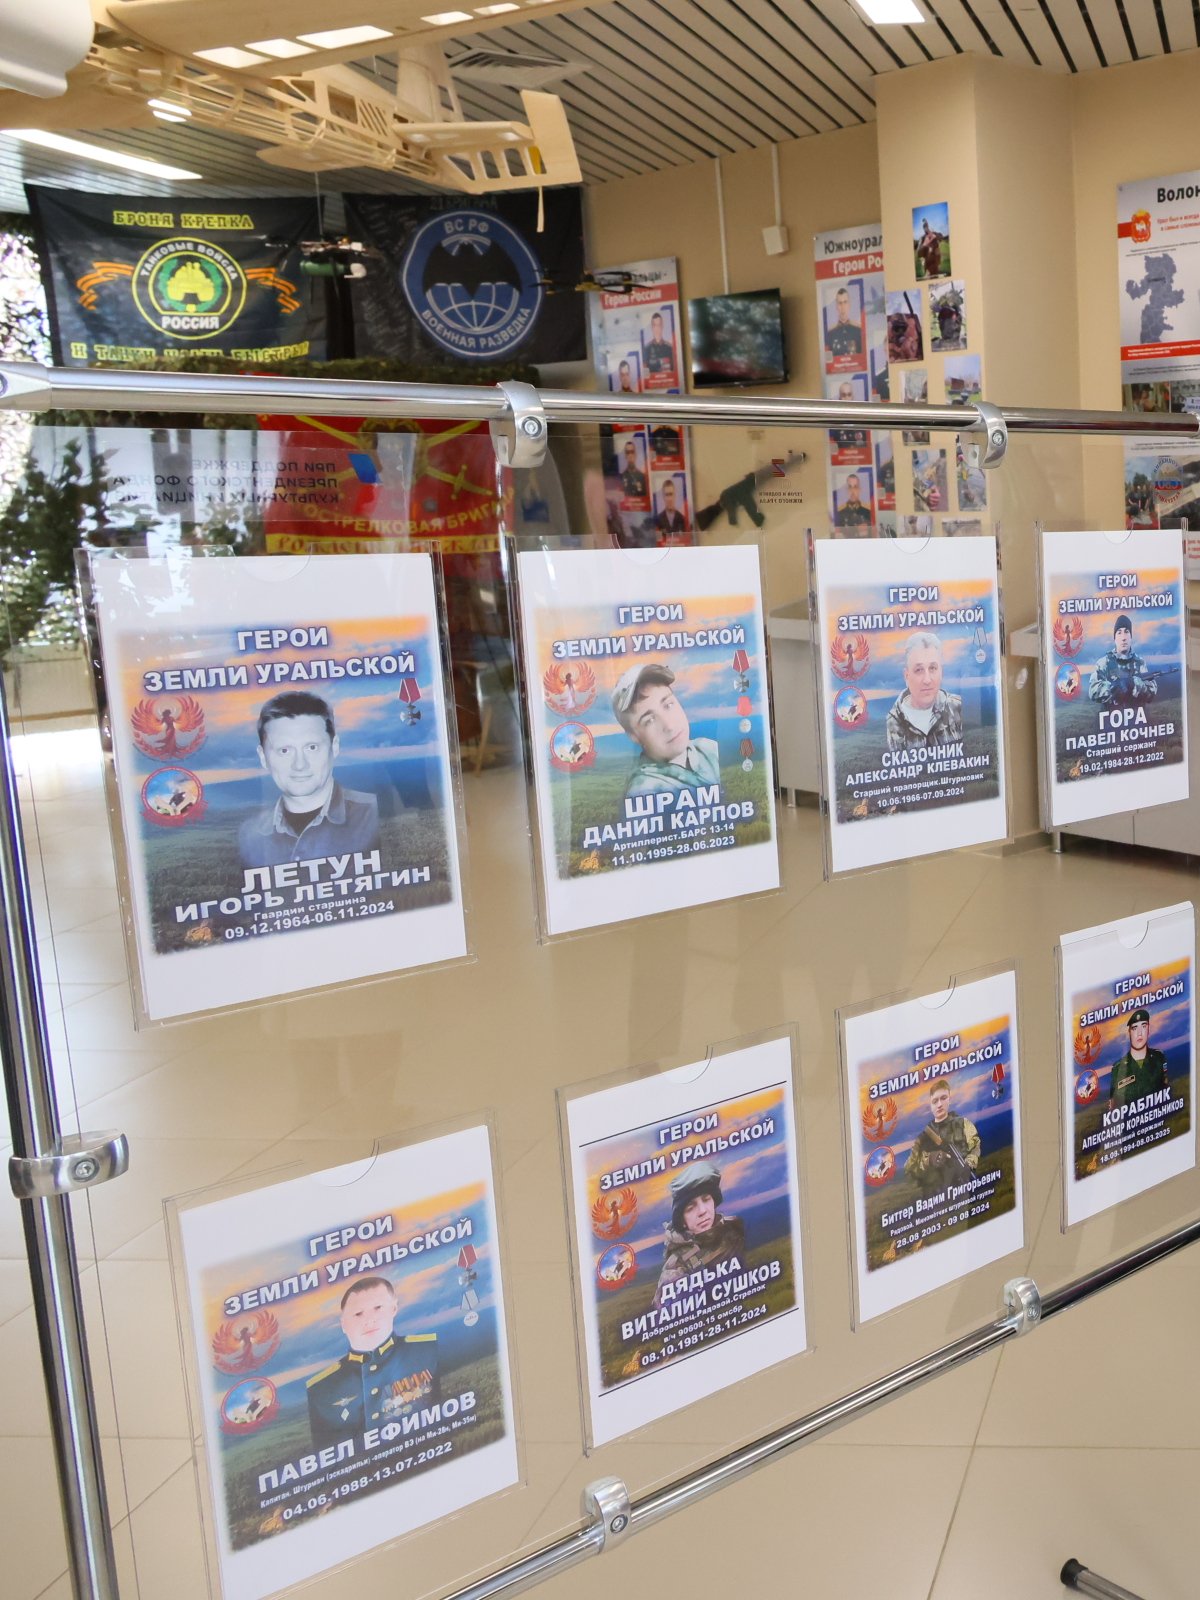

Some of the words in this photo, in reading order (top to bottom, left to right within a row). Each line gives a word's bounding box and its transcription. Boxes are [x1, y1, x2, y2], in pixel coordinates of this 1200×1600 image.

[113, 211, 174, 228] БРОНЯ
[181, 213, 255, 229] КРЕПКА
[443, 219, 465, 234] ВС
[468, 219, 490, 233] РФ
[140, 242, 194, 277] ТАНКОВЫЕ
[197, 245, 239, 281] ВОЙСКА
[833, 259, 865, 276] Герои
[161, 316, 220, 330] РОССИЯ
[421, 309, 476, 349] ВОЕННАЯ
[480, 307, 532, 349] РАЗВЕДКА
[889, 586, 939, 603] ГЕРОИ
[1099, 574, 1137, 588] ГЕРОИ
[619, 604, 683, 624] ГЕРОИ
[838, 613, 894, 631] ЗЕМЛИ
[898, 606, 984, 628] УРАЛЬСКОЙ
[1059, 599, 1102, 614] ЗЕМЛИ
[1106, 591, 1173, 611] УРАЛЬСКОЙ
[237, 626, 328, 651] ГЕРОИ
[553, 637, 626, 659] ЗЕМЛИ
[632, 624, 745, 652] УРАЛЬСКОЙ
[144, 666, 248, 692] ЗЕМЛИ
[256, 651, 416, 684] УРАЛЬСКОЙ
[1099, 706, 1147, 730] ГОРА
[1066, 732, 1116, 751] ПАВЕЛ
[1120, 723, 1175, 742] КОЧНЕВ
[1086, 745, 1122, 758] Старший
[1123, 740, 1157, 752] сержант
[845, 764, 923, 787] АЛЕКСАНДР
[927, 755, 990, 774] КЛЕВАКИН
[882, 742, 964, 768] СКАЗОЧНИК
[624, 784, 720, 819] ШРАМ
[853, 786, 891, 799] Старший
[583, 816, 664, 848] ДАНИЛ
[671, 801, 755, 830] КАРПОВ
[613, 827, 707, 852] Артиллерист.БАРС
[709, 822, 735, 834] 13-14
[612, 835, 735, 866] 11.10.1995-28.06.2023
[241, 850, 381, 893] ЛЕТУН
[175, 893, 285, 923] ИГОРЬ
[294, 866, 431, 903] ЛЕТЯГИН
[254, 906, 305, 922] Гвардии
[308, 895, 366, 914] старшина
[225, 900, 395, 940] 09.12.1964-06.11.2024
[1115, 973, 1151, 995] ГЕРОИ
[1080, 1004, 1119, 1027] ЗЕМЛИ
[1121, 980, 1184, 1013] УРАЛЬСКОЙ
[915, 1034, 960, 1061] ГЕРОИ
[869, 1072, 920, 1099] ЗЕМЛИ
[923, 1041, 1002, 1081] УРАЛЬСКОЙ
[1102, 1087, 1171, 1127] КОРАБЛИК
[659, 1112, 719, 1145] ГЕРОИ
[1082, 1122, 1125, 1151] АЛЕКСАНДР
[1126, 1098, 1184, 1131] КОРАБЕЛЬНИКОВ
[600, 1156, 666, 1190] ЗЕМЛИ
[670, 1118, 775, 1167] УРАЛЬСКОЙ
[881, 1206, 914, 1228] Биттер
[915, 1192, 945, 1214] Вадим
[947, 1169, 1001, 1200] Григорьевич
[308, 1215, 393, 1257] ГЕРОИ
[921, 1223, 941, 1238] 2003
[948, 1216, 958, 1226] 09
[959, 1211, 969, 1221] 08
[970, 1202, 990, 1216] 2024
[223, 1270, 319, 1317] ЗЕМЛИ
[326, 1217, 473, 1283] УРАЛЬСКОЙ
[660, 1256, 742, 1304] ДЯДЬКА
[621, 1287, 707, 1341] ВИТАЛИЙ
[712, 1260, 781, 1301] СУШКОВ
[717, 1304, 743, 1320] омсбр
[641, 1303, 767, 1366] 08.10.1981-28.11.2024
[258, 1438, 355, 1494] ПАВЕЛ
[363, 1391, 477, 1450] ЕФИМОВ
[282, 1440, 453, 1521] 04.06.1988-13.07.2022
[292, 1475, 325, 1495] Штурман
